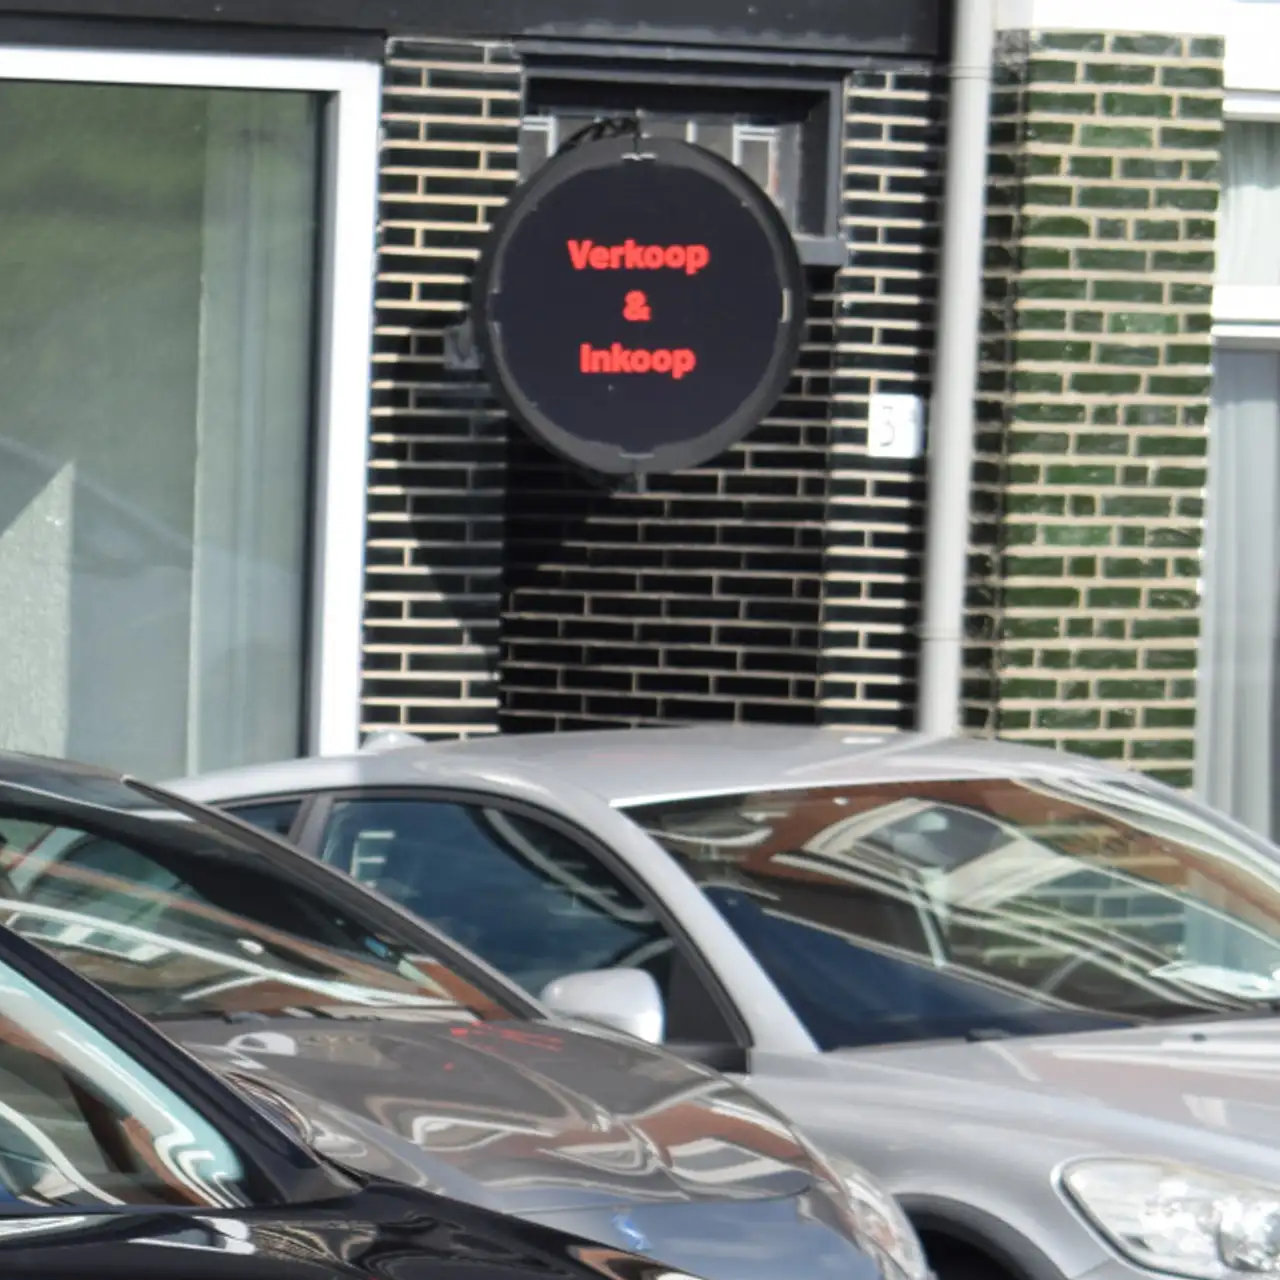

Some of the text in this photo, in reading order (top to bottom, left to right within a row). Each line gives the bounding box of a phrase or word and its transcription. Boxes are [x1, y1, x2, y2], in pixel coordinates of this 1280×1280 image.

[567, 239, 710, 275] Verkoop
[623, 290, 651, 321] &
[580, 342, 696, 379] Inkoop
